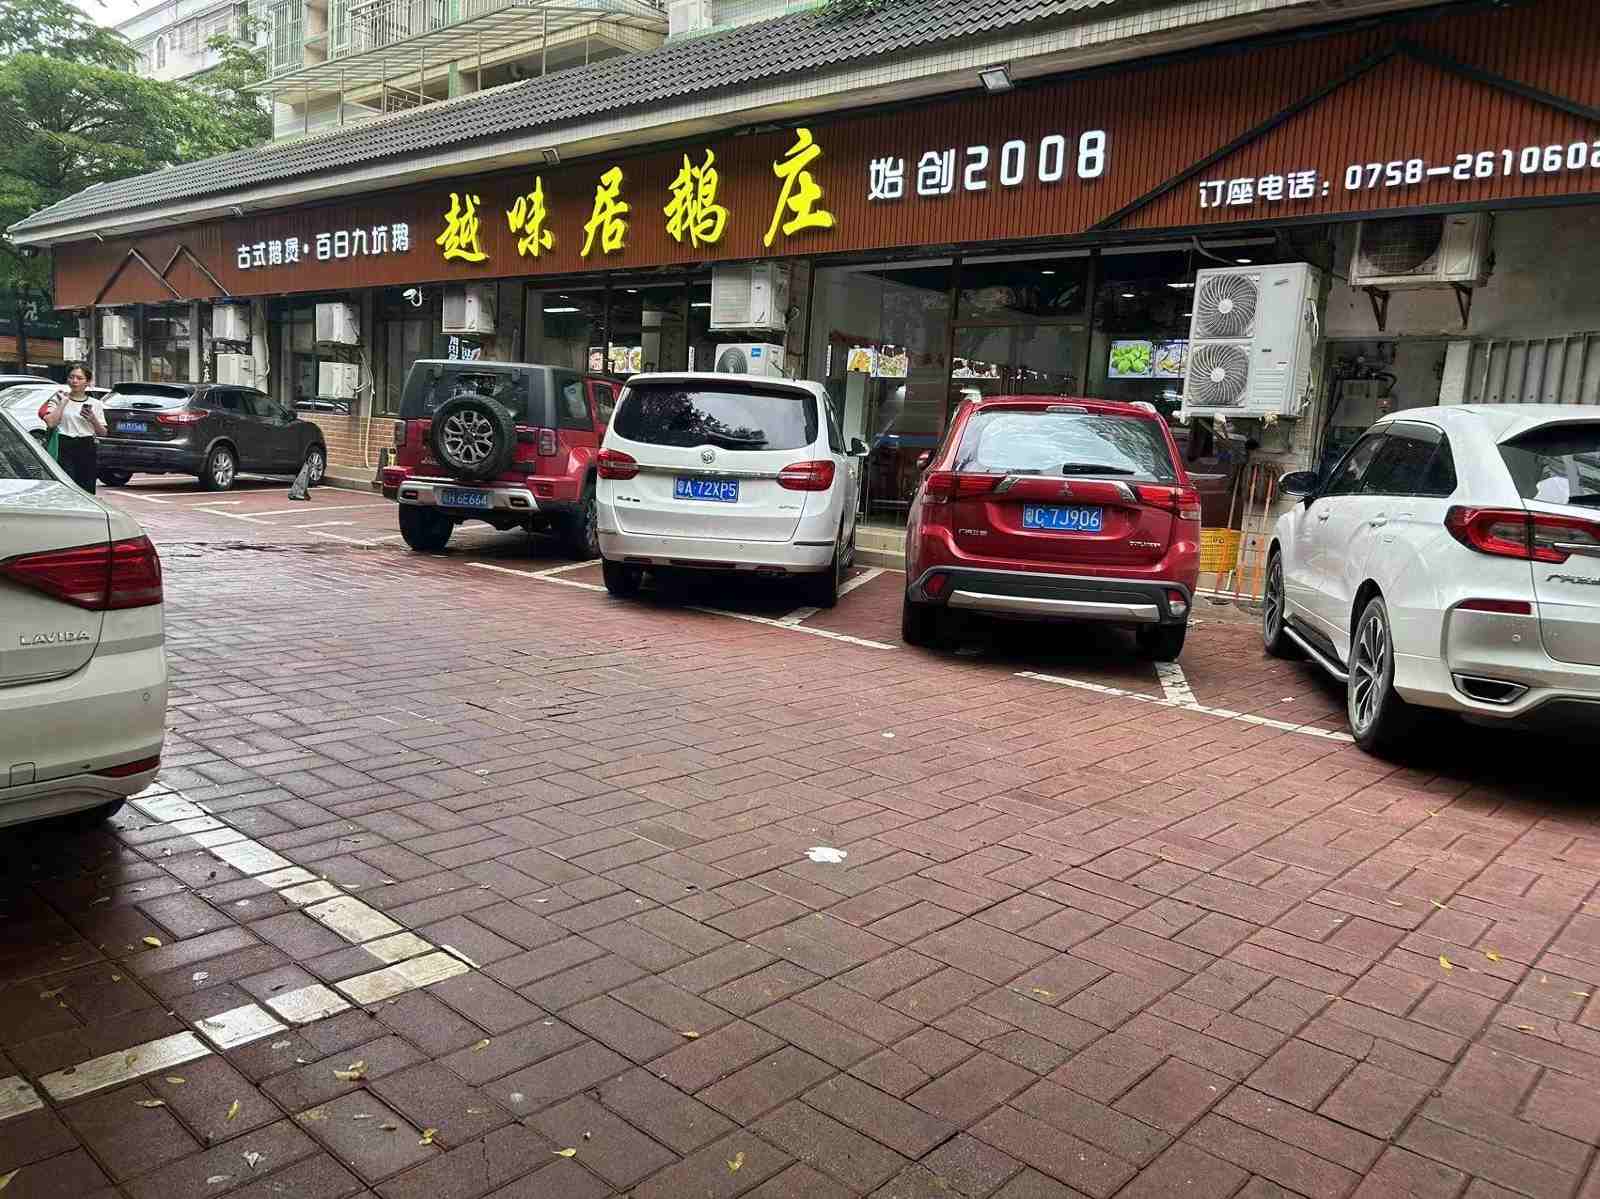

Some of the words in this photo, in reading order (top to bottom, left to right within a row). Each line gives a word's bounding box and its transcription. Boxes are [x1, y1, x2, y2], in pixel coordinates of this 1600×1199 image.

[435, 127, 835, 262] 越味居鹅庄
[867, 129, 1107, 201] 始创2008
[19, 630, 91, 646] LAVIDA
